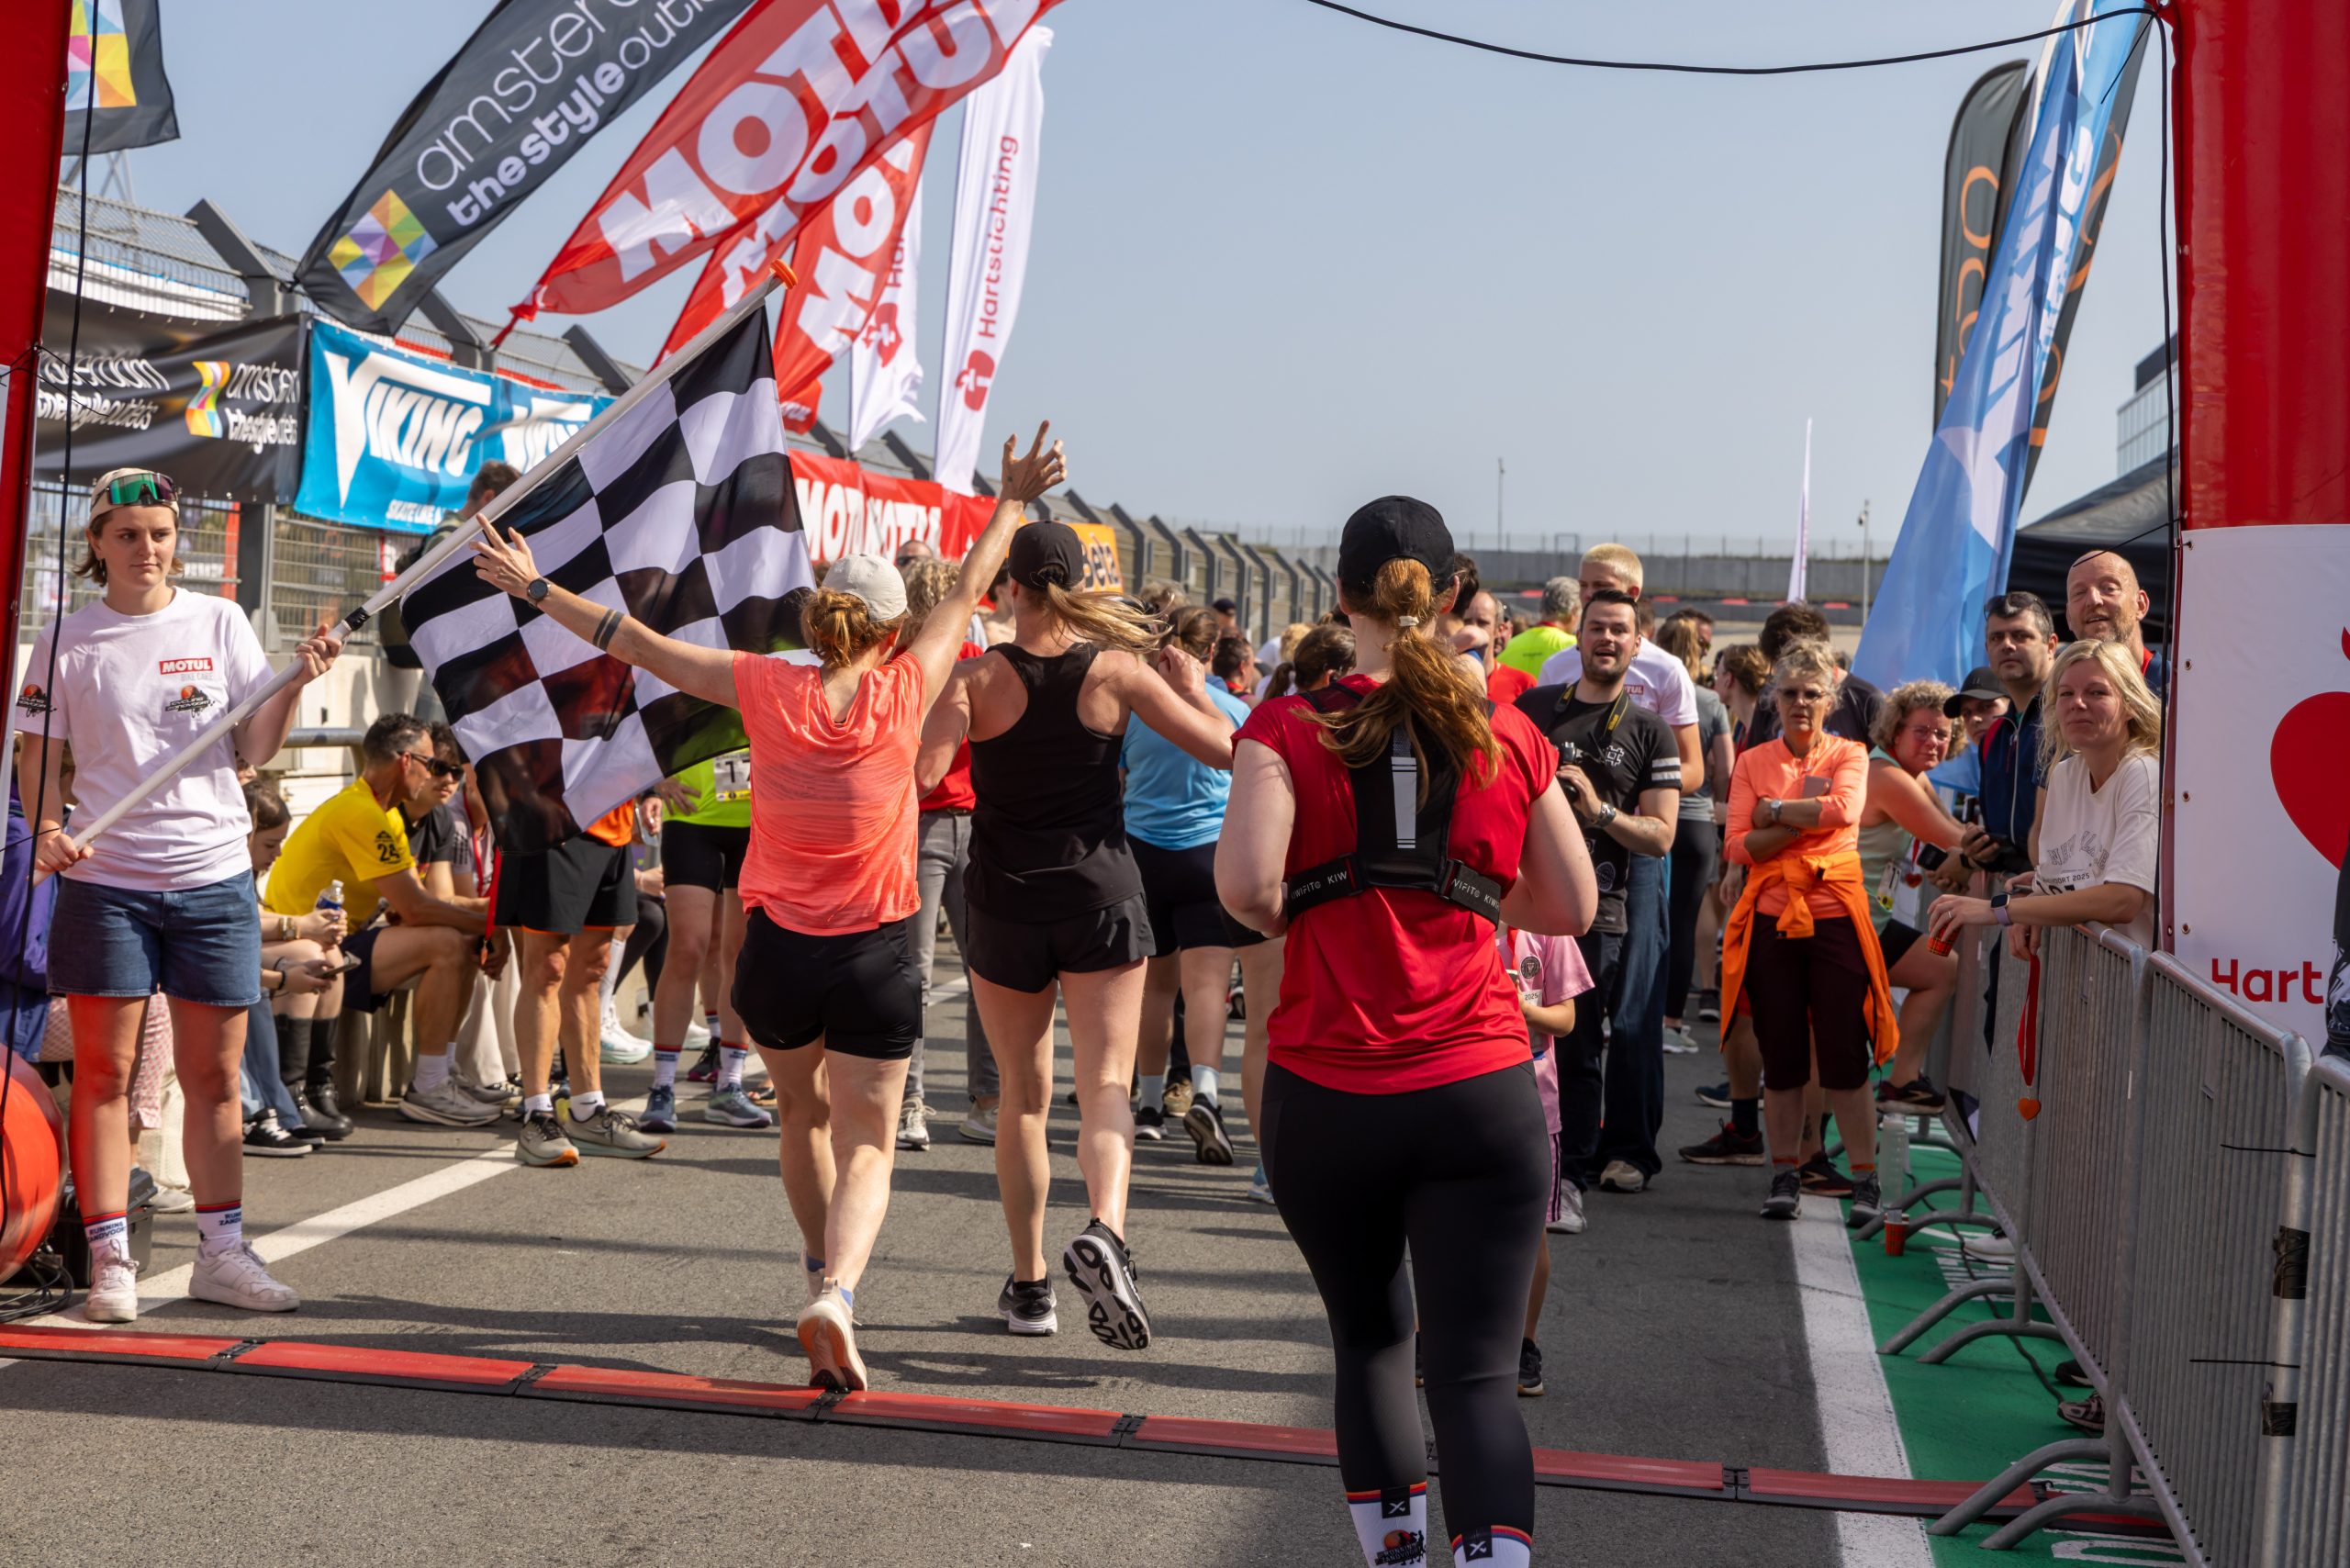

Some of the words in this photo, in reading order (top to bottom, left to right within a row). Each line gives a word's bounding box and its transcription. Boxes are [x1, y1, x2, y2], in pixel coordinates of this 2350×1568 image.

[418, 0, 641, 190] amster
[446, 0, 722, 226] thestyleout
[796, 138, 916, 368] MO
[978, 135, 1019, 339] Hartstichting
[323, 351, 491, 510] VIKING
[162, 659, 212, 673] MOTUL
[1624, 686, 1642, 694] TUL
[1327, 871, 1348, 885] KIW
[2072, 872, 2090, 881] 2025
[2211, 958, 2324, 1004] Hart
